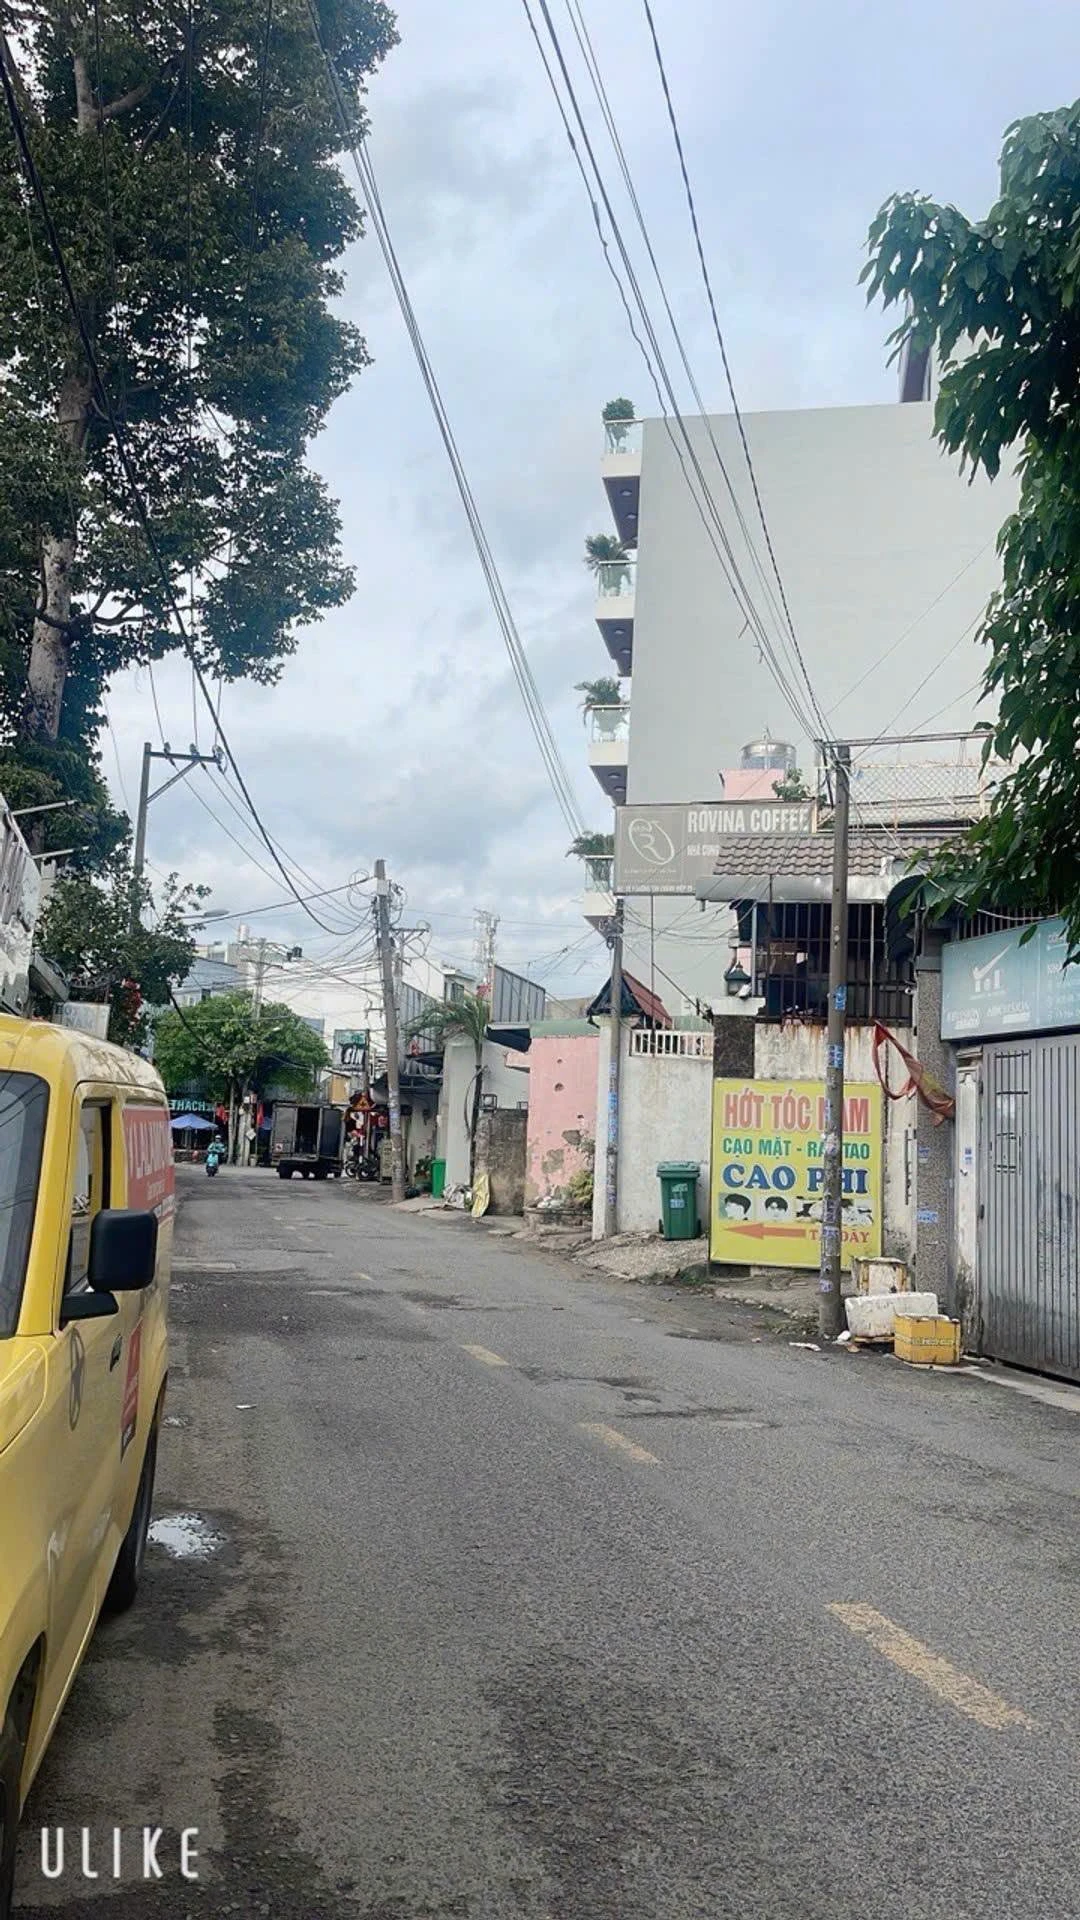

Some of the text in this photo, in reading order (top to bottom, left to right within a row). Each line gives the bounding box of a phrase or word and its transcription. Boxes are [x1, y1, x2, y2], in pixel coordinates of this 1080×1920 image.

[687, 808, 810, 833] ROVINA COFFEE
[725, 1088, 764, 1129] HỚT
[771, 1089, 810, 1131] TÓC
[723, 1138, 752, 1158] CẠO
[759, 1136, 791, 1159] MẶT
[723, 1164, 796, 1190] CAO
